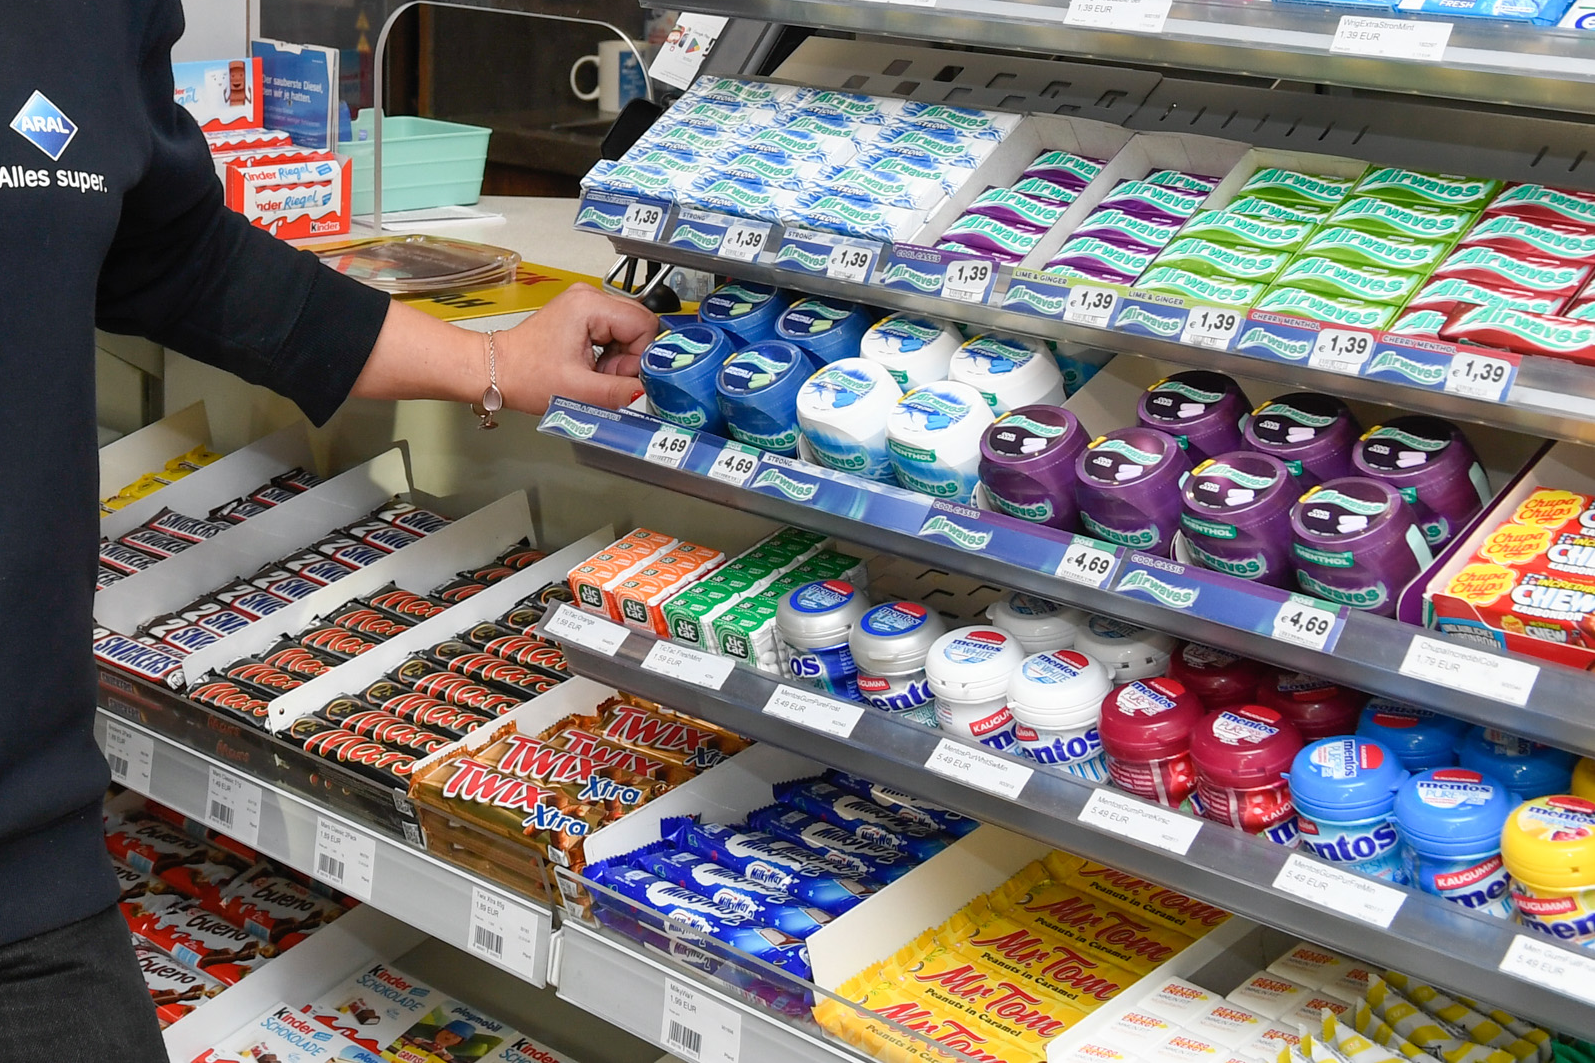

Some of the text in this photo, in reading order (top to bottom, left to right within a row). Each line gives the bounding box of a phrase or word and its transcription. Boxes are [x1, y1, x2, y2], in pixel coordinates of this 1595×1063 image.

[1360, 31, 1380, 42] EUR
[274, 77, 323, 94] sauberste Diesel,
[274, 89, 282, 97] wir
[284, 89, 290, 100] je
[22, 116, 70, 134] ARAL
[56, 169, 107, 193] super.
[278, 164, 312, 182] Riegel
[284, 190, 319, 209] Riegel
[634, 209, 658, 225] 1,39
[682, 212, 706, 221] STRONG
[673, 226, 762, 251] Airwaves 1,39
[1015, 270, 1067, 285] LIME GINGER
[1007, 286, 1113, 310] Airwaves 1,39
[1252, 312, 1320, 330] CHERRY MENTHOL
[1245, 328, 1368, 355] Airwaves 1,39
[658, 436, 687, 453] 4,69
[933, 501, 980, 519] COOL CASSIS
[921, 516, 1110, 573] Airwaves 4,69
[1296, 547, 1351, 568] MENTHOL
[626, 609, 646, 623] tac
[627, 601, 644, 613] tic
[568, 622, 582, 632] EUR
[577, 613, 595, 625] Orange
[95, 636, 179, 676] SNICKERS
[191, 682, 269, 716] Mars
[304, 729, 414, 774] Mars
[1417, 779, 1493, 793] mentos
[443, 757, 589, 836] TWIX Xtra
[1436, 858, 1502, 889] KAUGUMMI
[1307, 876, 1328, 891] EUR
[487, 906, 499, 918] EUR
[186, 912, 249, 942] bueno
[356, 974, 425, 1012] SCHOKOLADE
[683, 1000, 698, 1014] EUR
[925, 987, 1022, 1037] Peanuts Caramel
[984, 982, 1066, 1038] Tom
[451, 1005, 503, 1033] playmobil
